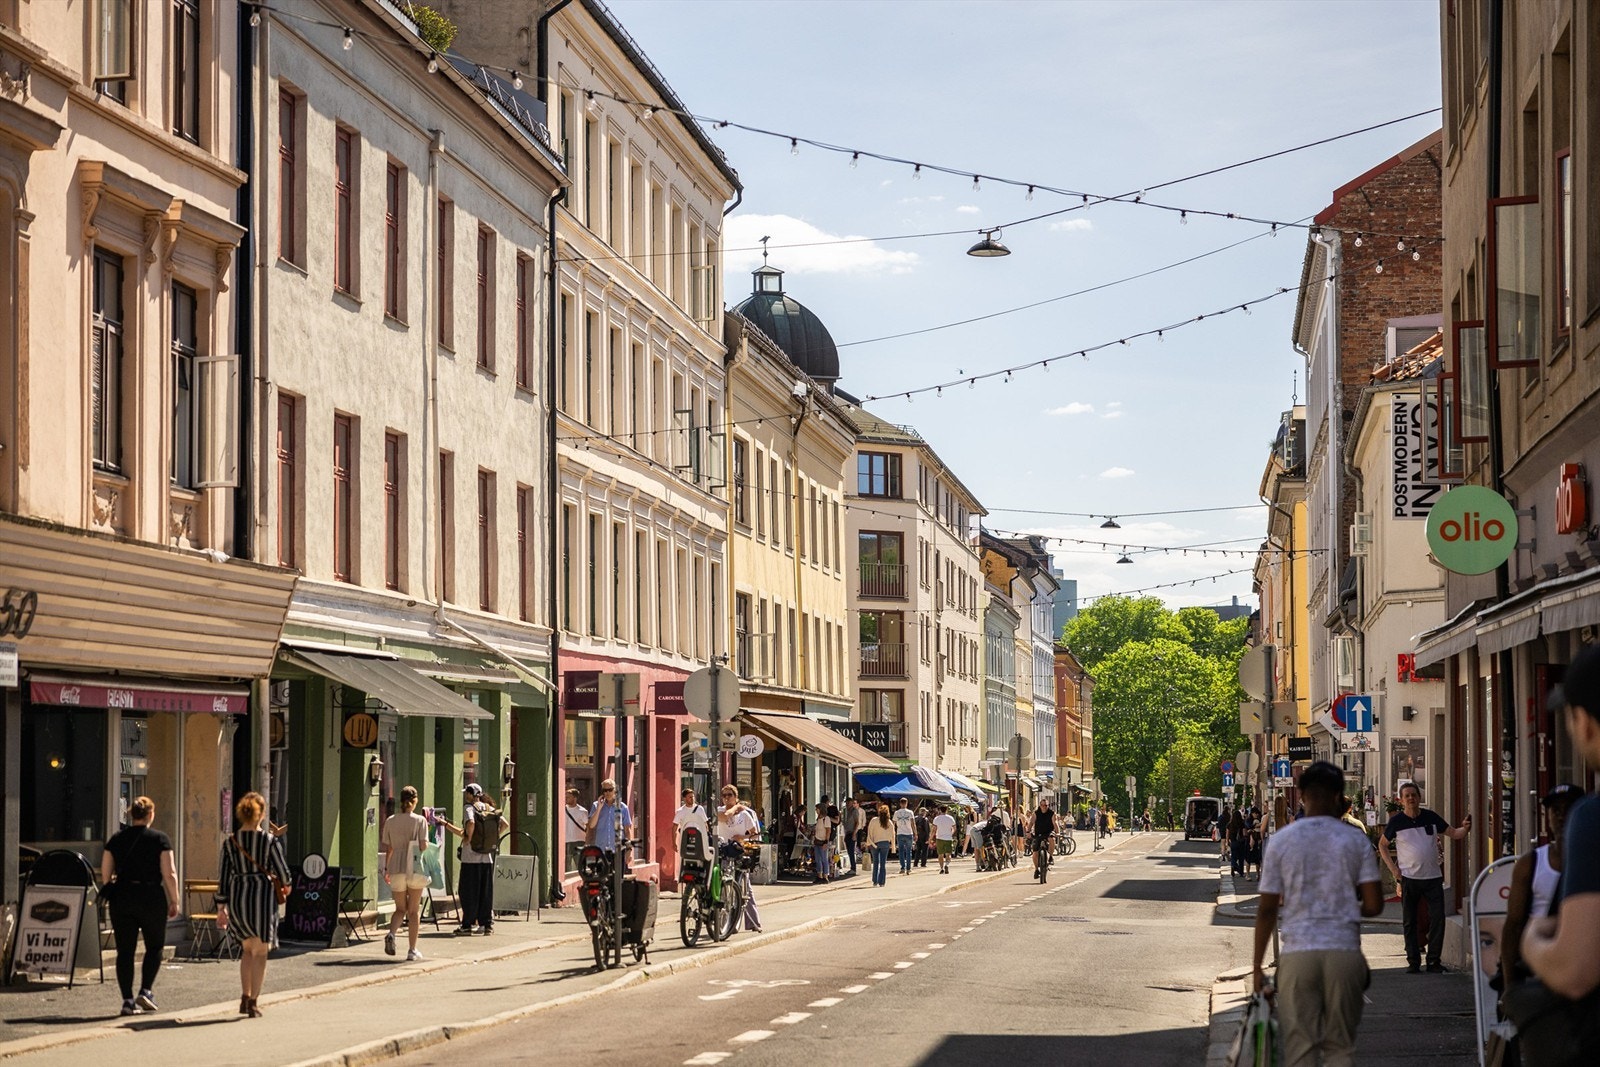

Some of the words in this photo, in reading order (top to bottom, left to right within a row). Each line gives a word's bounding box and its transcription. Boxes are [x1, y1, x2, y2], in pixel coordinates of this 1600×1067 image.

[1394, 401, 1408, 517] POSTMODERN
[1439, 512, 1505, 542] olio
[350, 718, 373, 742] LUV
[866, 731, 886, 739] NOA
[866, 739, 886, 747] NOA
[26, 932, 40, 947] Vi
[42, 932, 67, 947] har
[24, 949, 65, 965] åpent
